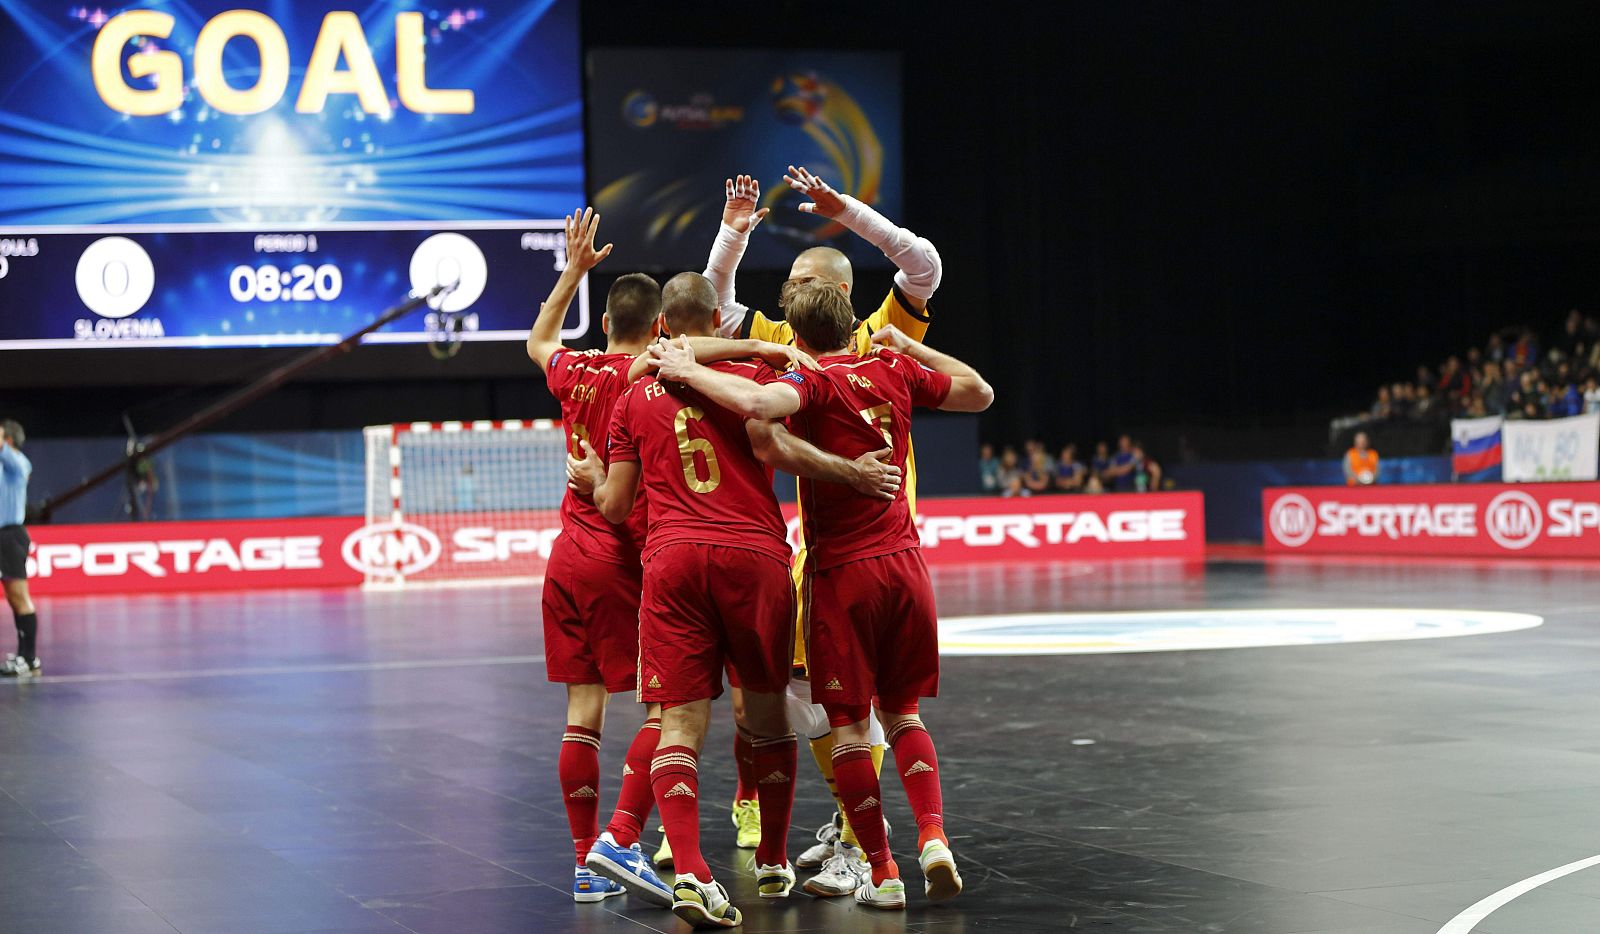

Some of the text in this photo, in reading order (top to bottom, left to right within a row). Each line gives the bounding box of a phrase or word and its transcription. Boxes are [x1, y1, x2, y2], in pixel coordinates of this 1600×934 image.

[92, 9, 475, 116] GOAL
[102, 259, 130, 298] 0
[229, 263, 343, 302] 08:20
[74, 317, 165, 340] SLOVENIA
[674, 406, 720, 494] 6
[917, 509, 1187, 548] PORTAGE
[1318, 502, 1478, 539] SPORTAGE
[1498, 502, 1533, 536] KIA
[25, 536, 323, 577] PORTAGE
